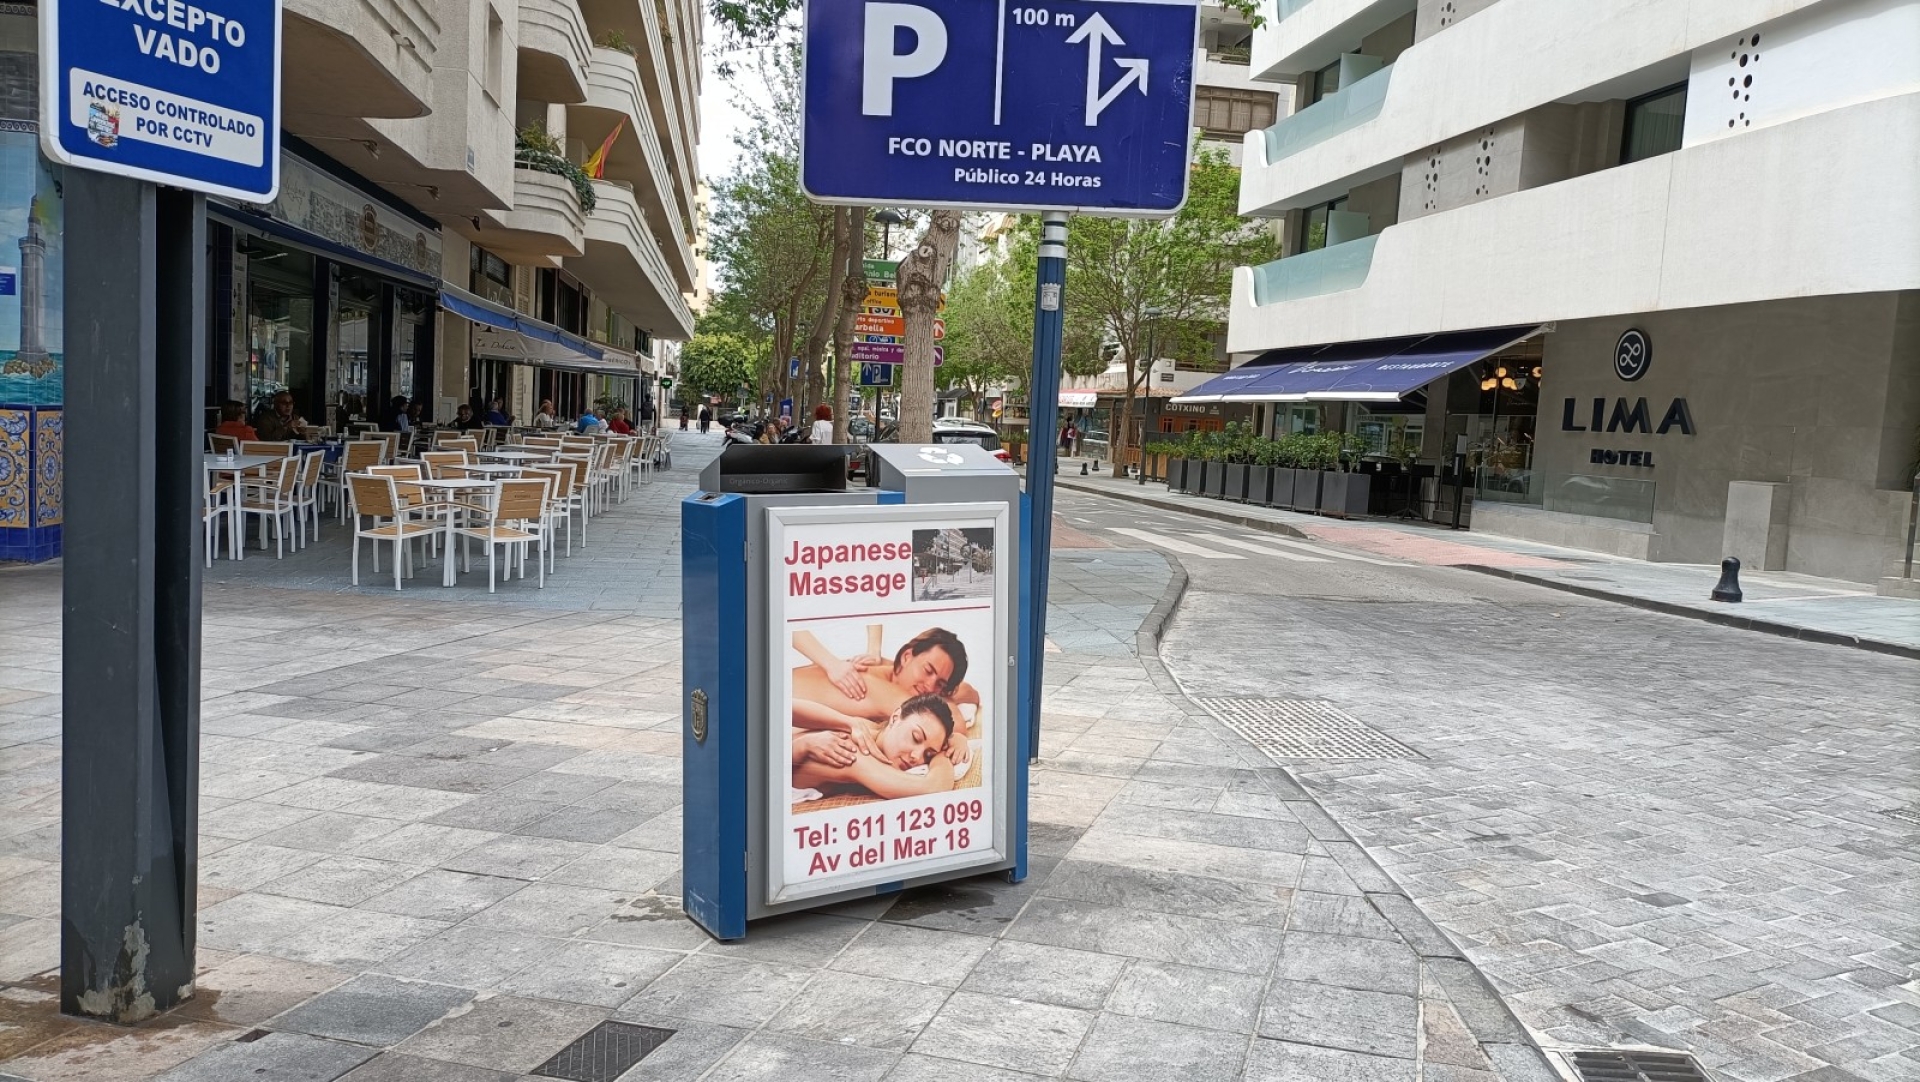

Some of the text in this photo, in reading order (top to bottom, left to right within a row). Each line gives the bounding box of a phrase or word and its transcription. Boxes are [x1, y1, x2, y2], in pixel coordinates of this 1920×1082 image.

[1012, 8, 1075, 27] 100 m
[133, 24, 221, 74] VADO
[862, 1, 948, 116] P
[83, 81, 256, 138] ACCESO CONTROLADO
[136, 116, 213, 148] POR CCTV
[888, 137, 932, 157] FCO
[938, 139, 1011, 161] NORTE
[1031, 143, 1102, 163] PLAYA
[954, 167, 1102, 188] Público 24 Horas
[855, 324, 884, 332] arbella
[1165, 403, 1206, 413] COTXINO
[1562, 397, 1697, 435] LIMA
[1590, 449, 1656, 467] HOTEL
[784, 540, 912, 569] Japanese
[789, 571, 907, 599] Massage
[794, 800, 983, 851] Tel: 611 123 099
[808, 827, 970, 877] Av del Mar 18
